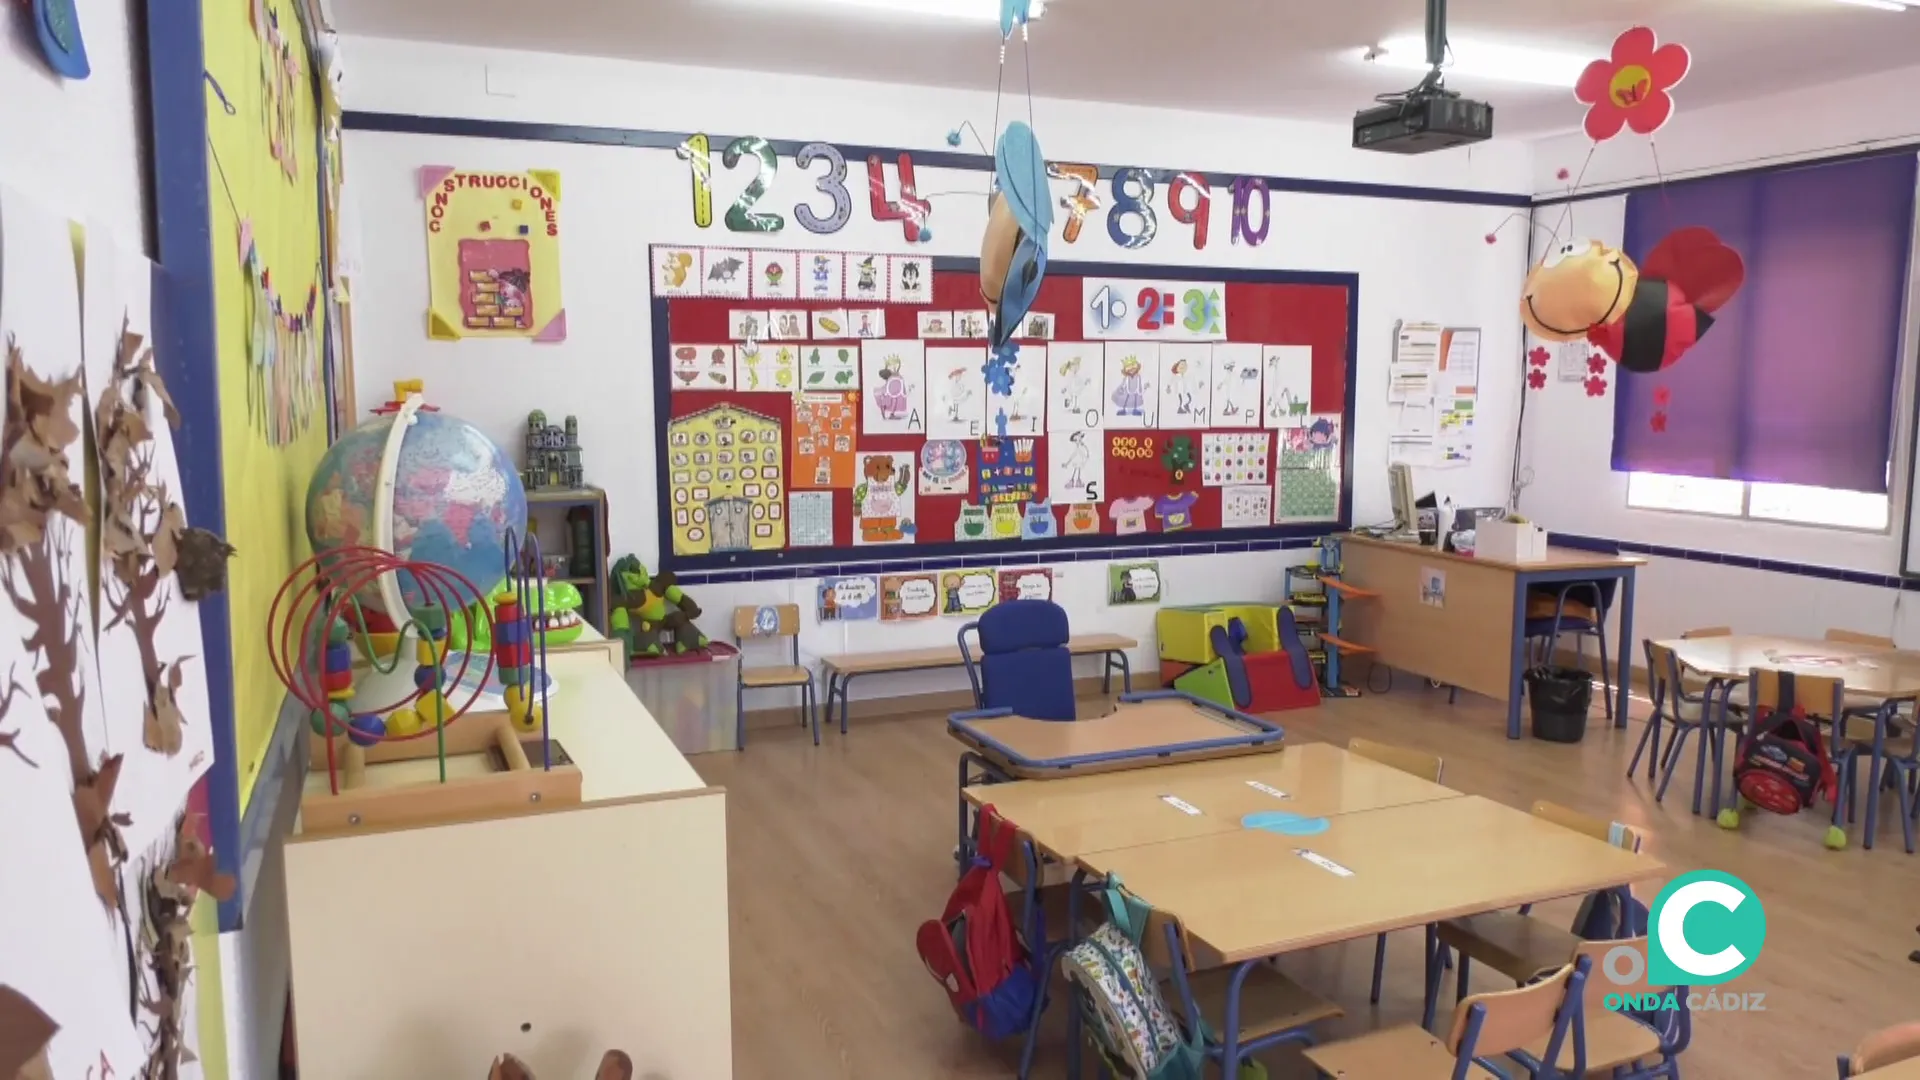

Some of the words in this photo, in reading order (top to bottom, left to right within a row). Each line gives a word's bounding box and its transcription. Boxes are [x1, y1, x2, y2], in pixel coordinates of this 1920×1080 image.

[676, 132, 712, 228] 1
[722, 135, 784, 232] 2
[794, 142, 851, 234] 3
[867, 152, 931, 242] 4
[1047, 162, 1100, 243] 7
[1106, 167, 1157, 249] 8
[1167, 172, 1211, 250] 9
[1227, 175, 1270, 247] 10
[429, 174, 558, 237] CONSTRUCCIONES
[1137, 287, 1160, 330] 2
[1183, 289, 1206, 332] 3
[908, 408, 921, 430] A
[1143, 412, 1154, 428] U
[1193, 407, 1206, 424] M
[1245, 409, 1255, 424] P
[970, 420, 979, 436] E
[1086, 481, 1098, 500] S
